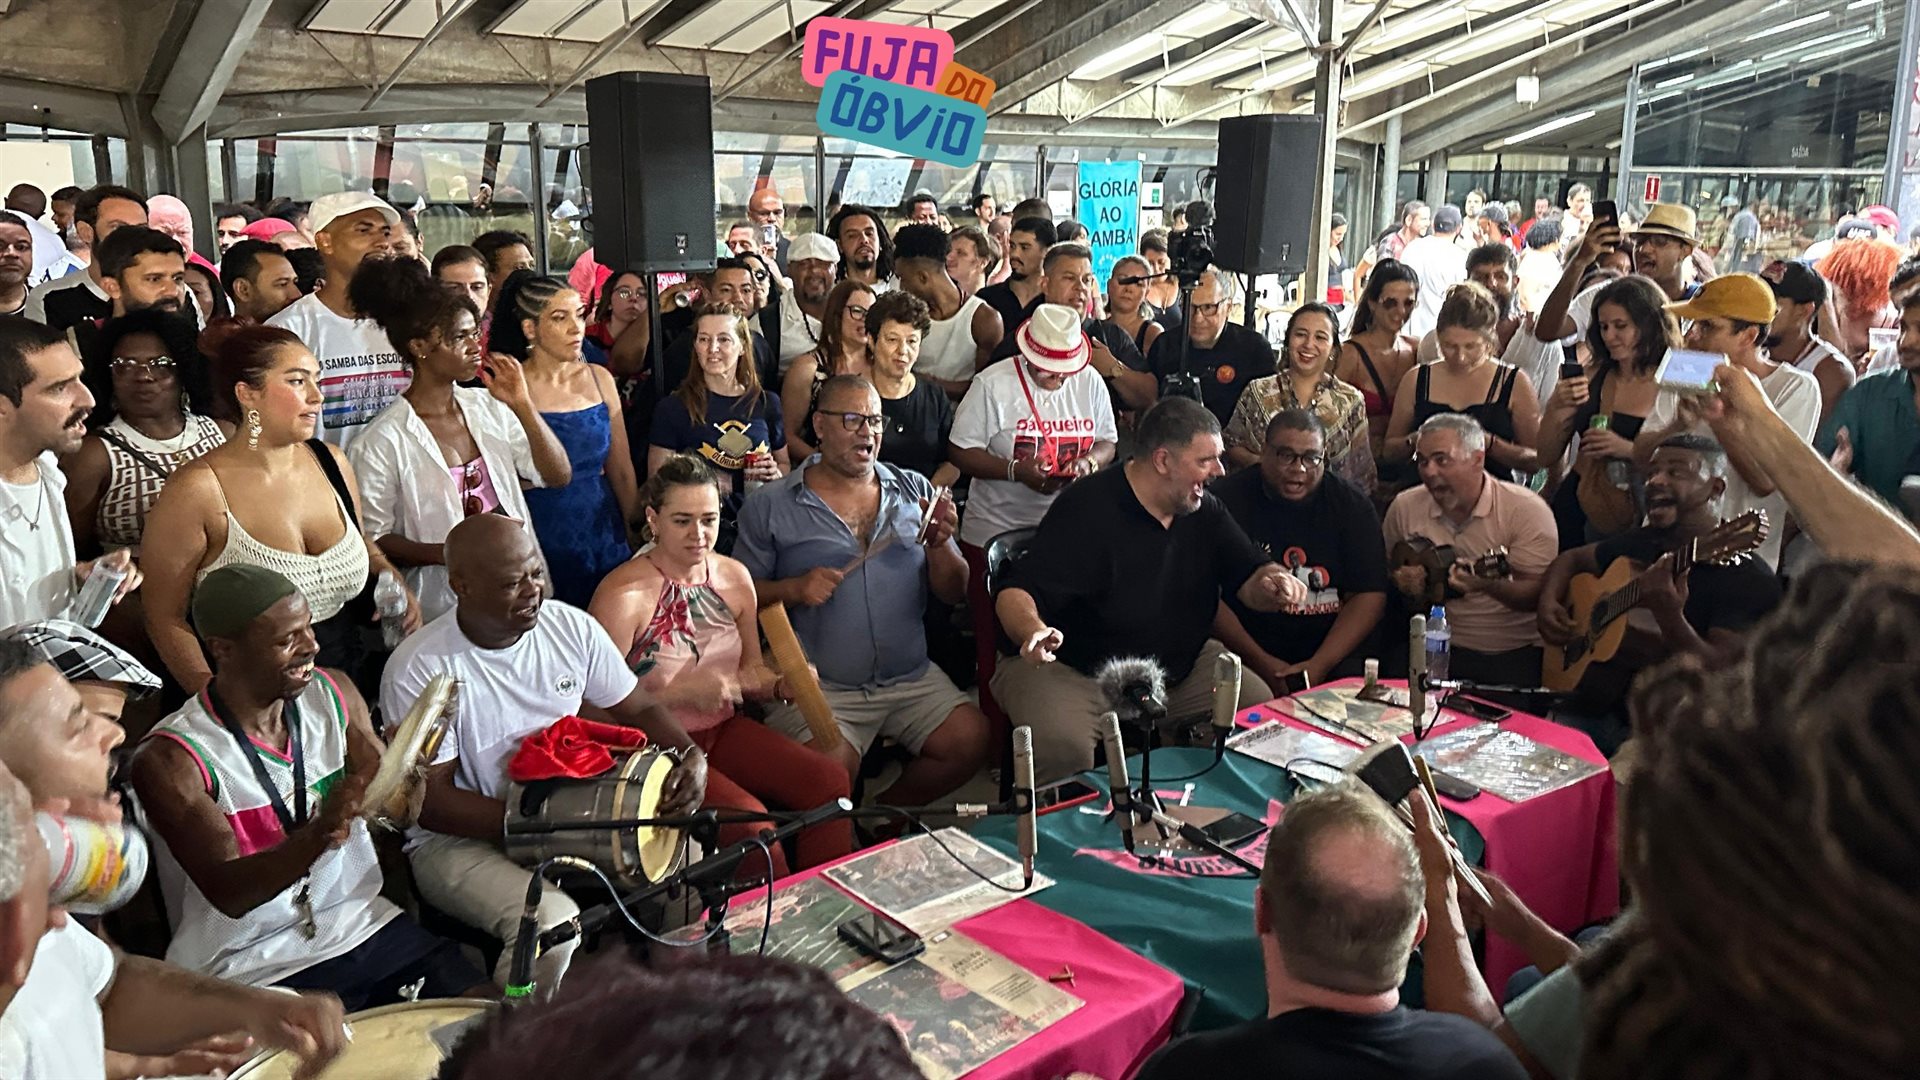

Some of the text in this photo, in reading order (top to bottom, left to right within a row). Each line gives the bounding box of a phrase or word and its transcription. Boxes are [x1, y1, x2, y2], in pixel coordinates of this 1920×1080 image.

[1100, 206, 1122, 224] AO
[1087, 228, 1134, 248] AMBA
[325, 356, 358, 371] SAMBA
[359, 354, 375, 367] DAS
[343, 373, 393, 389] SALGUEIRO
[344, 385, 397, 400] MANGUEIRA
